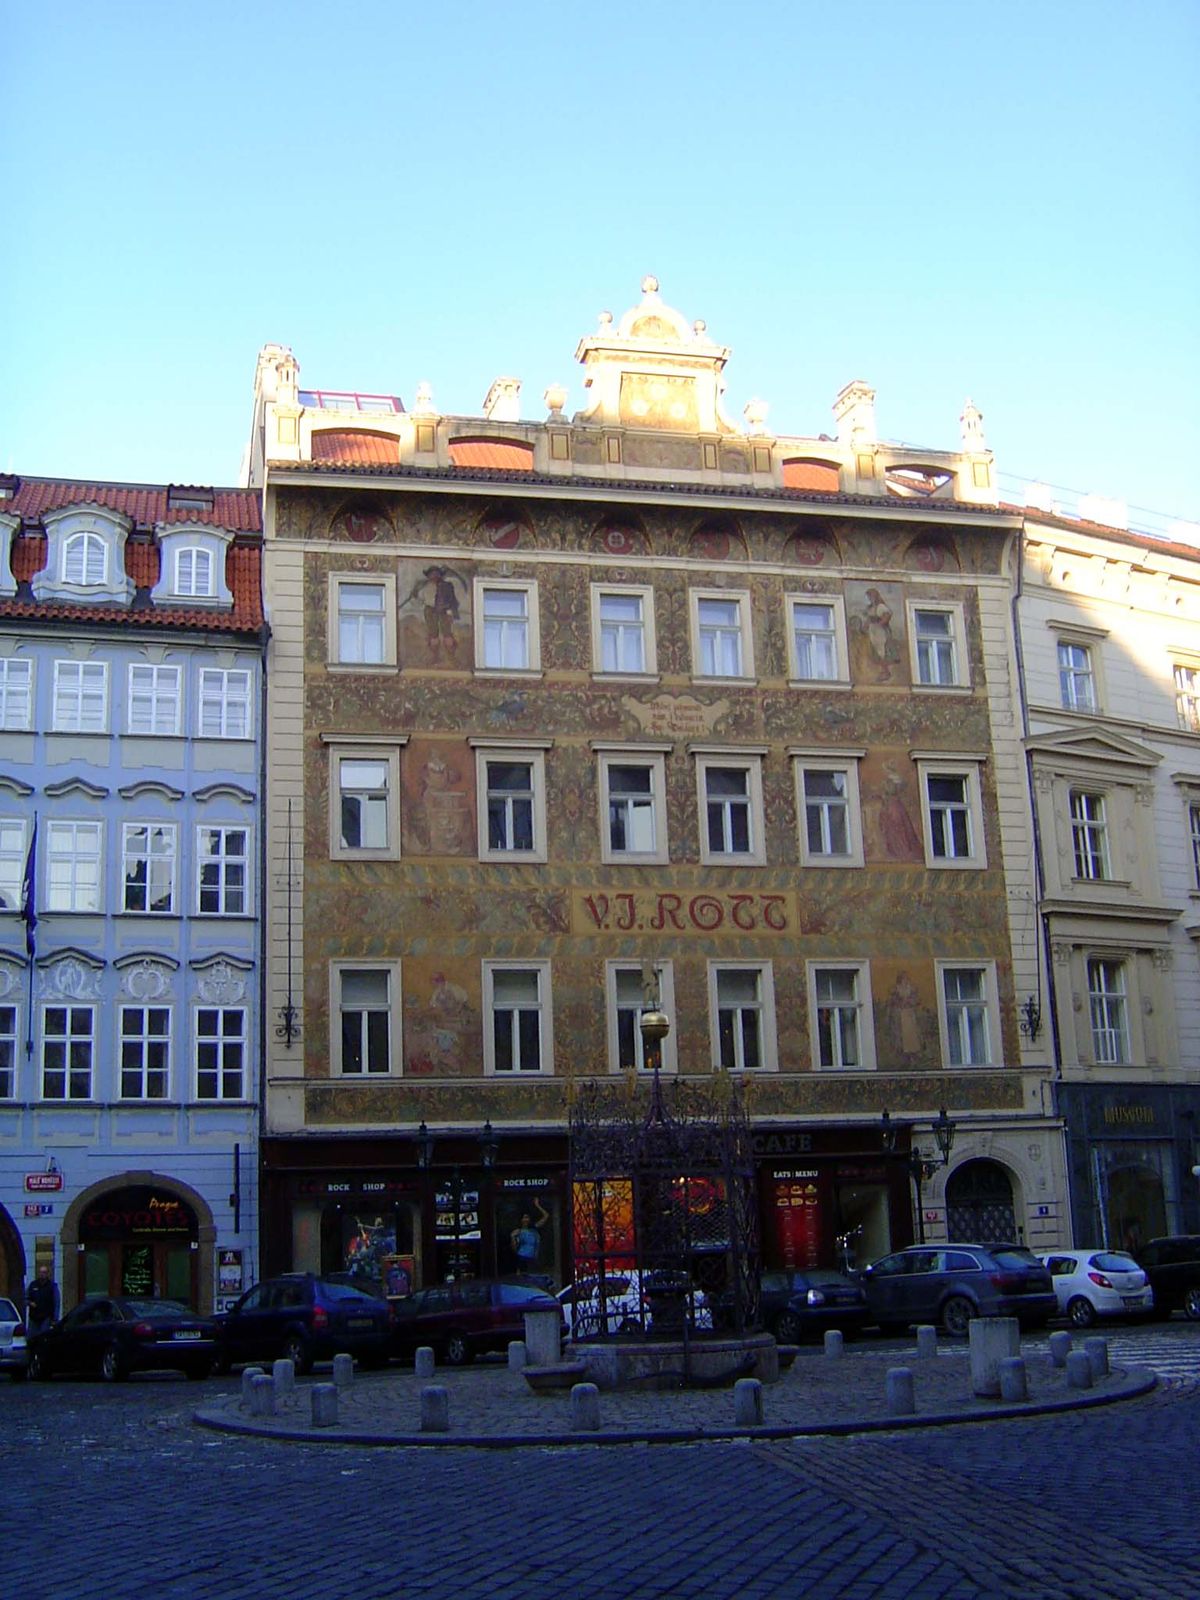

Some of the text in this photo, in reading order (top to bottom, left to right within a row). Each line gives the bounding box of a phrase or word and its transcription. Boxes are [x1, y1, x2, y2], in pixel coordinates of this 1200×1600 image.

[772, 1169, 819, 1179] EATS MENU
[327, 1183, 351, 1192] ROCK
[362, 1182, 386, 1192] SHOP
[503, 1178, 550, 1188] ROCK SHOP
[87, 1208, 191, 1228] COYOTES
